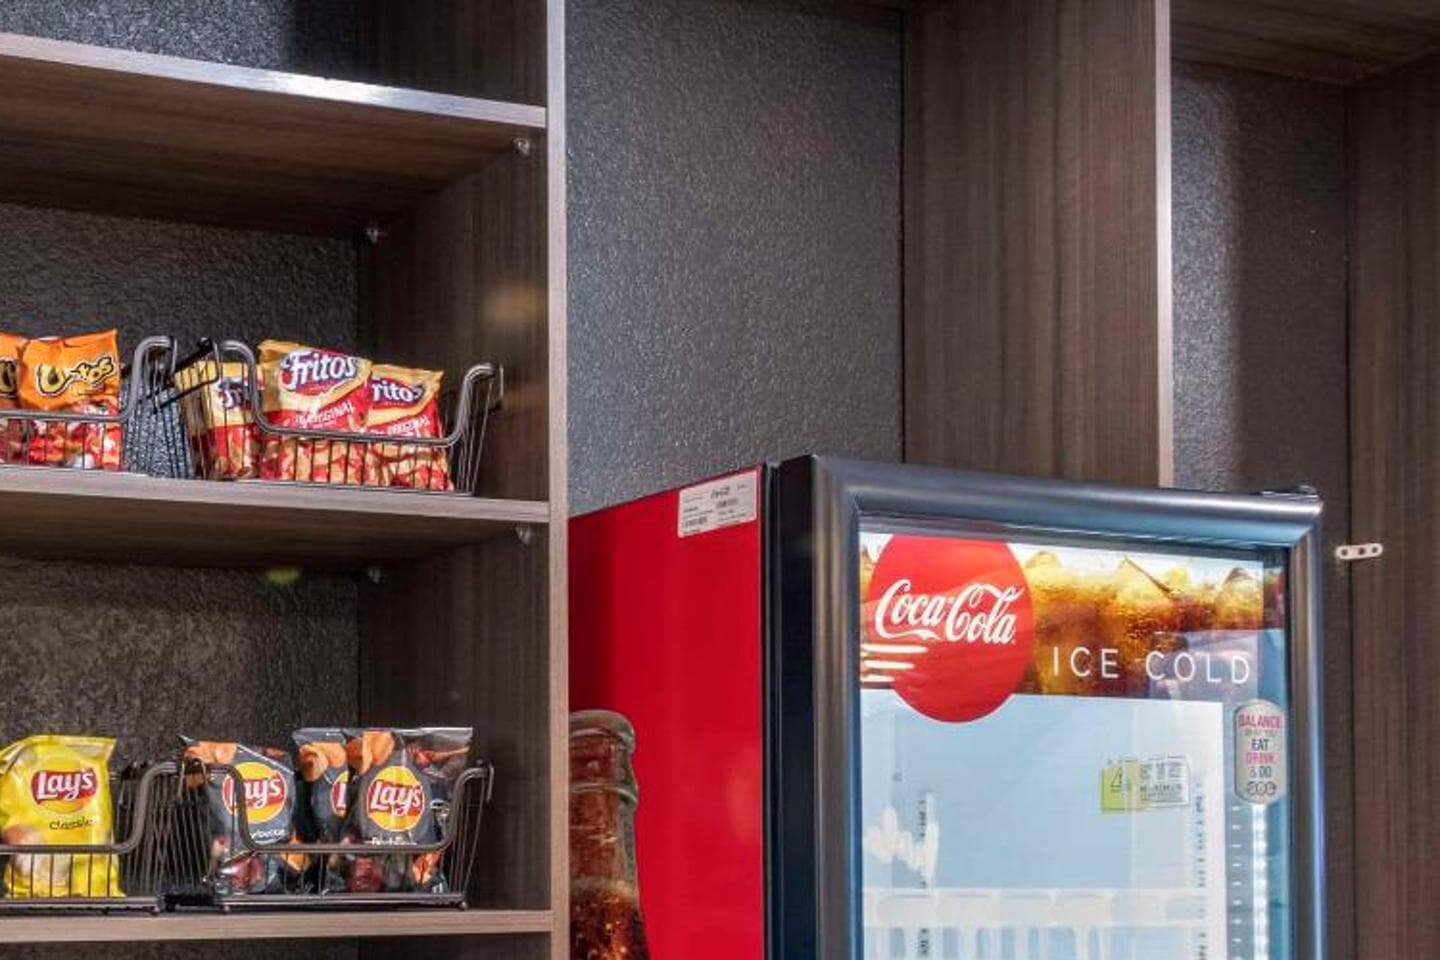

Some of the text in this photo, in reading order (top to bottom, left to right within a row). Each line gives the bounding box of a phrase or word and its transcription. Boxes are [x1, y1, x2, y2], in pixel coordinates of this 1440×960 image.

[280, 351, 358, 391] Fritos
[371, 376, 424, 403] ritos
[874, 578, 1025, 645] Coca-Cola
[1051, 645, 1251, 684] ICE COLD
[1238, 714, 1282, 728] BALANCE
[1251, 739, 1269, 751] EAT
[37, 768, 95, 800] Lay's
[371, 780, 423, 815] Lay's
